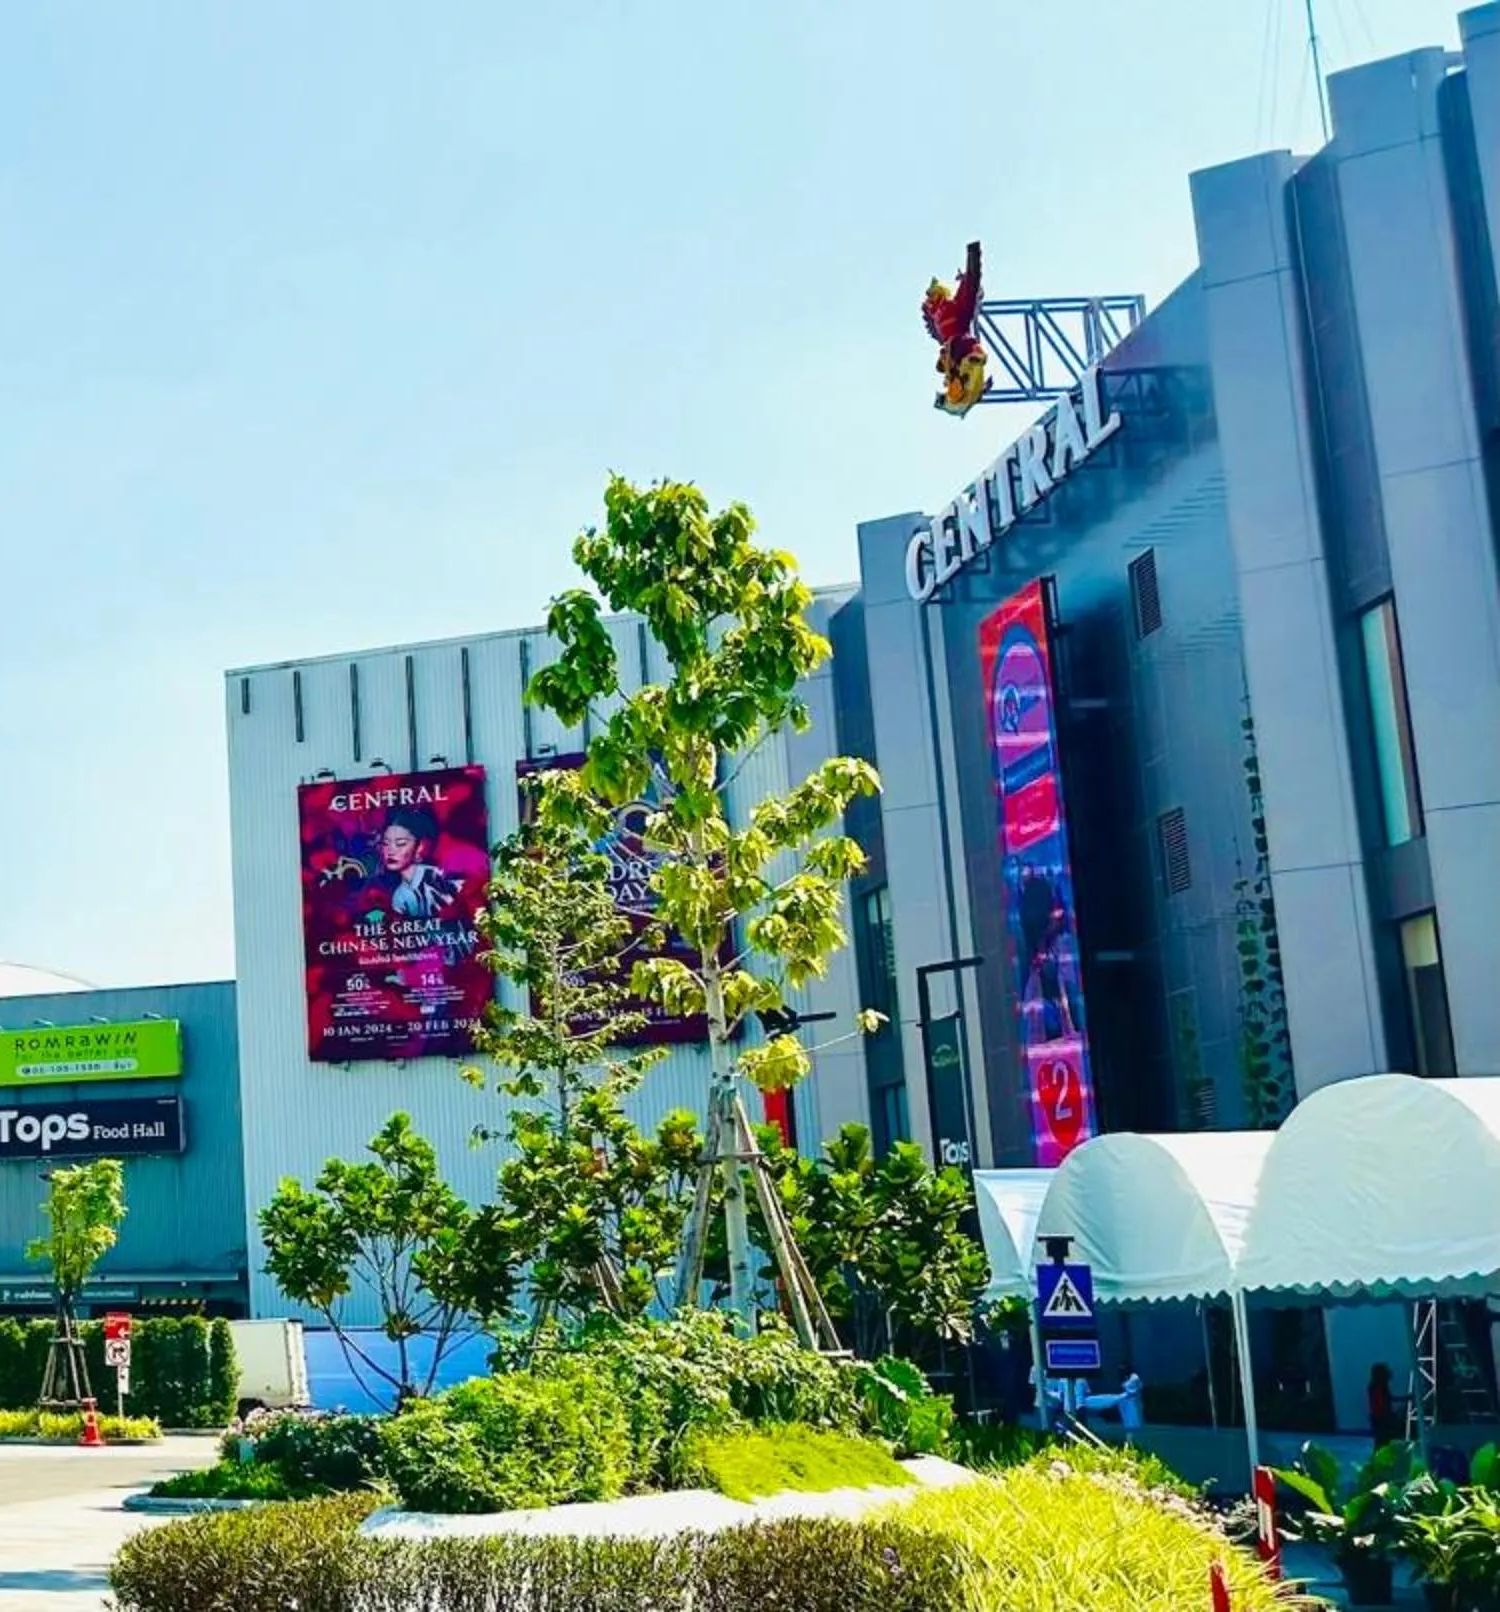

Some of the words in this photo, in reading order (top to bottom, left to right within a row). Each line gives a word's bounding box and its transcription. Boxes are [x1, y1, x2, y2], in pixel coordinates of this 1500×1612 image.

[906, 363, 1121, 601] CENTRAL
[328, 783, 449, 813] CENTRAL
[354, 924, 387, 938] THE
[391, 918, 442, 934] GREAT
[319, 937, 390, 956] CHINESE
[393, 934, 430, 950] NEW
[433, 930, 480, 946] YEAR
[364, 1022, 393, 1036] 2024
[407, 1021, 422, 1033] 20
[425, 1019, 450, 1032] FEB
[93, 1123, 130, 1140] Food
[132, 1120, 166, 1138] Hall
